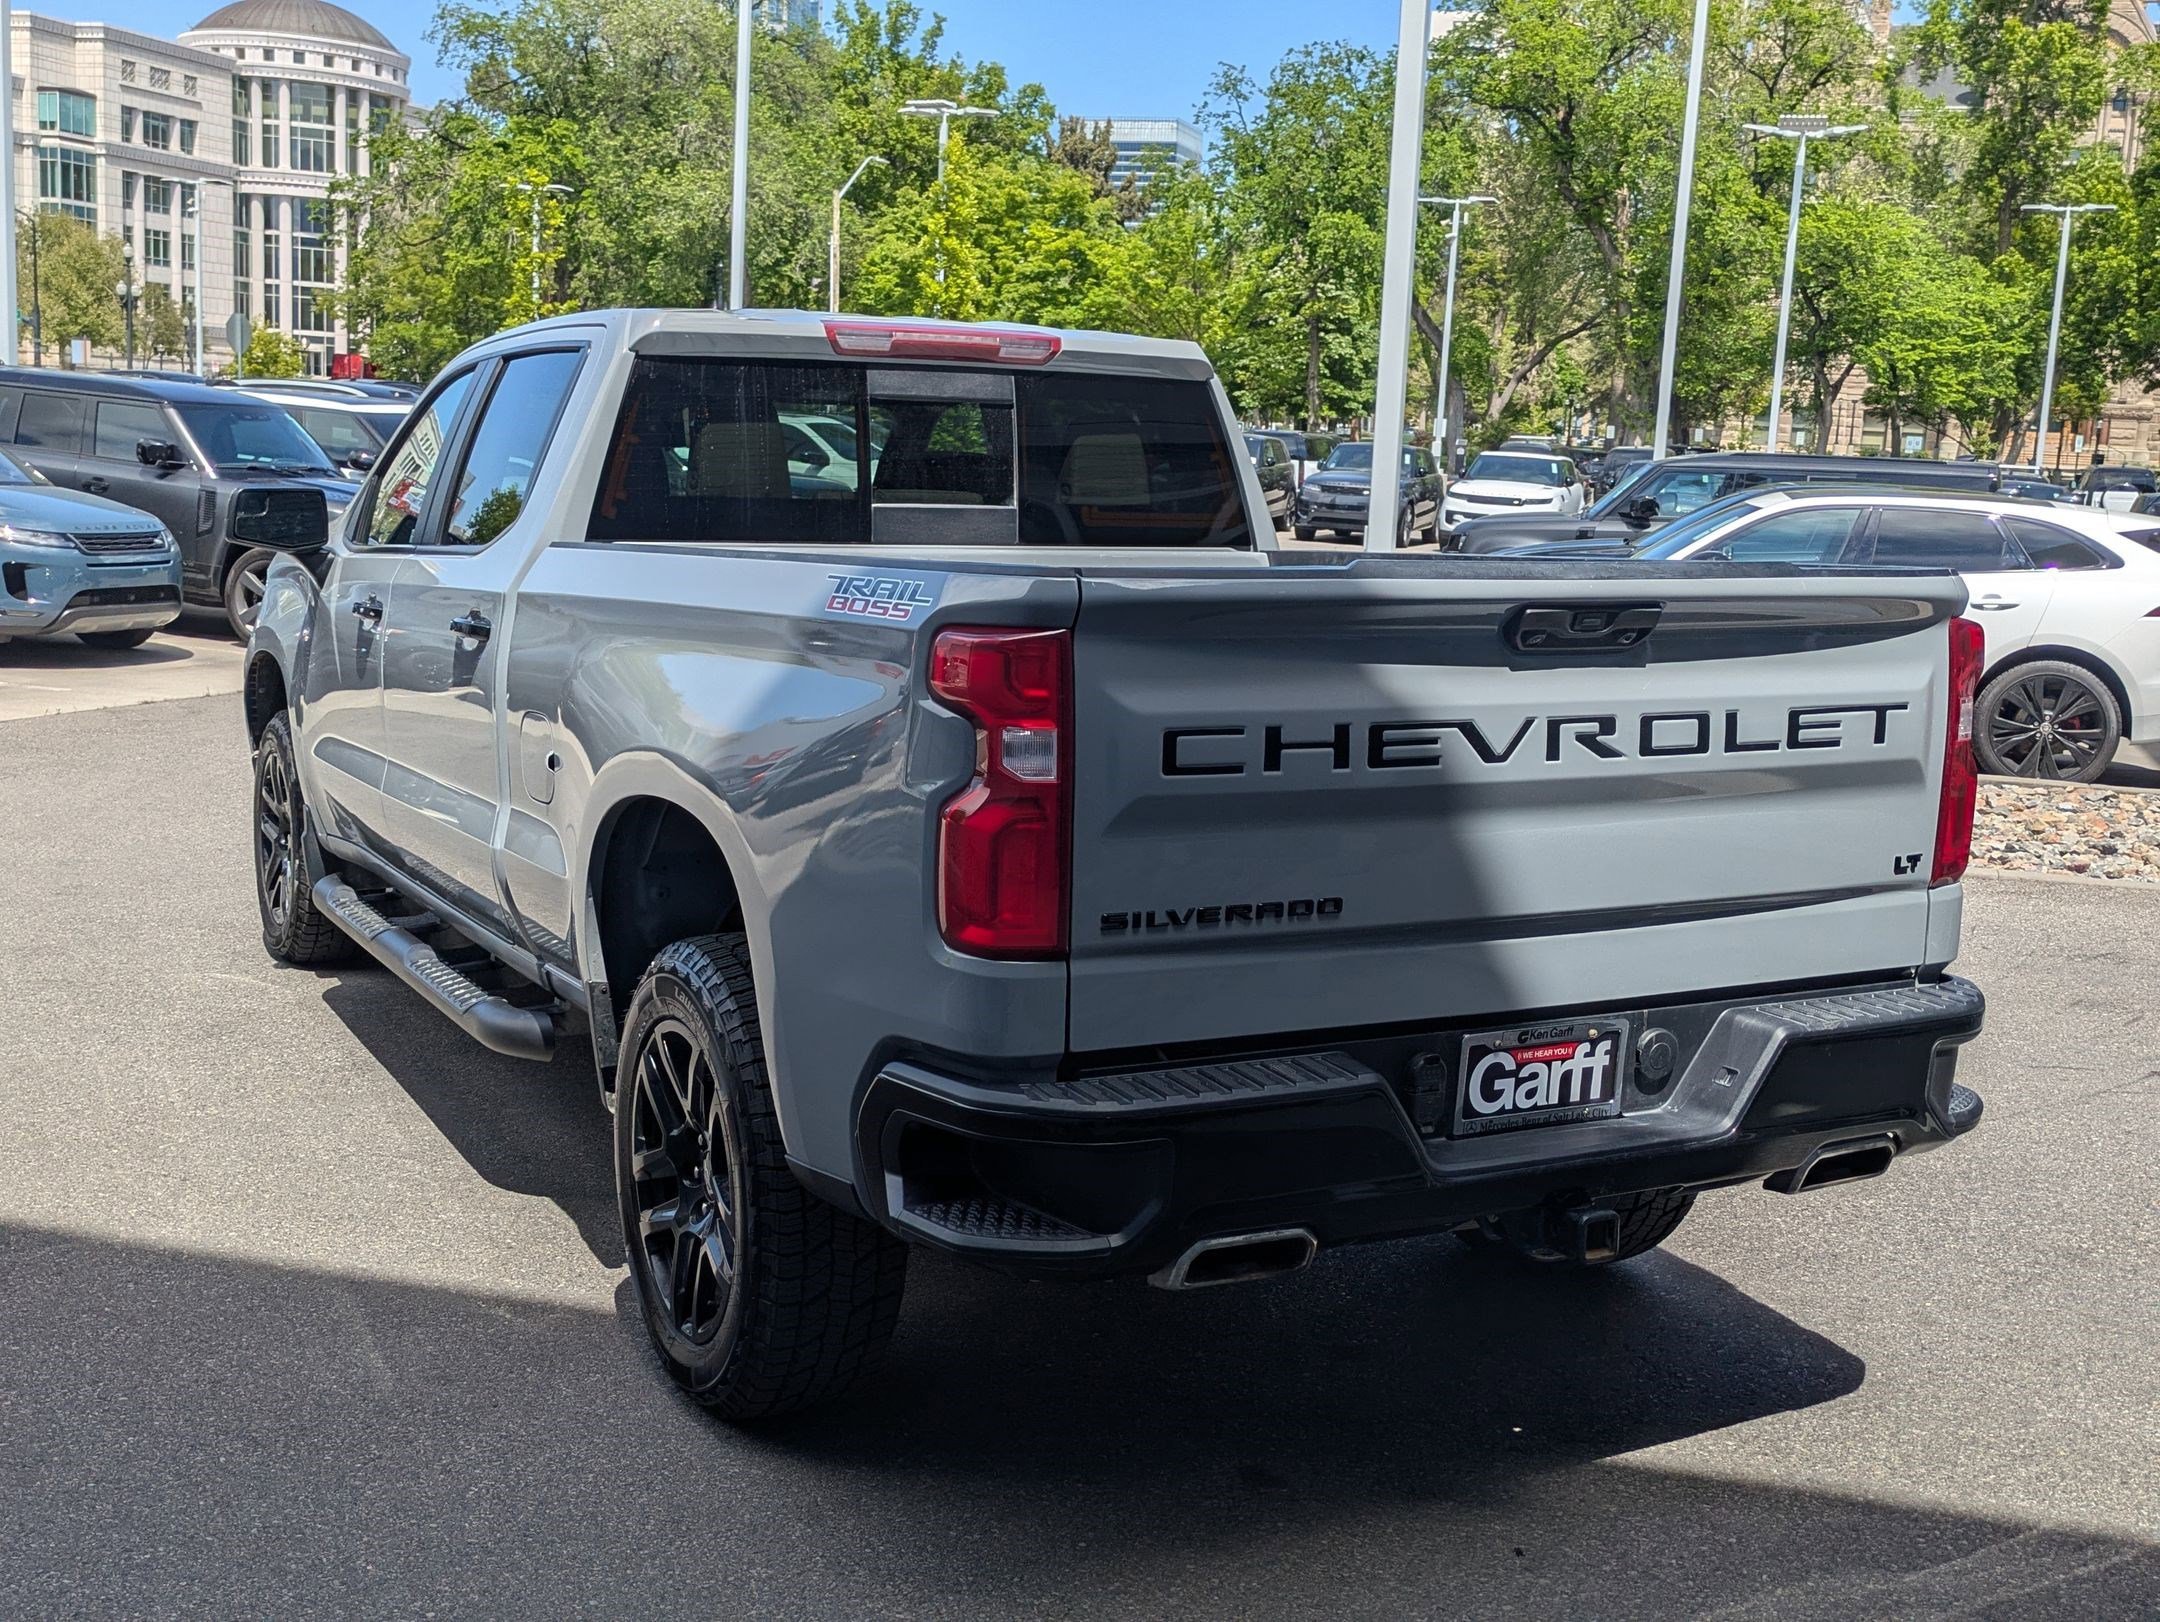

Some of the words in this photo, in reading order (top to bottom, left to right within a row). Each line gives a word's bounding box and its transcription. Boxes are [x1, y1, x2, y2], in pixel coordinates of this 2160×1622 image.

[827, 573, 933, 605] TRAIL
[825, 594, 914, 621] BOSS
[1161, 703, 1909, 776] CHEVROLET
[1893, 853, 1923, 875] LT
[1100, 897, 1344, 931] SILVERADO
[1529, 1028, 1549, 1041] Ken
[1550, 1025, 1574, 1038] Garff
[1523, 1050, 1534, 1059] WE
[1534, 1049, 1553, 1058] HEAR
[1553, 1047, 1568, 1056] YOU
[1469, 1040, 1612, 1114] Garff
[1592, 1107, 1610, 1119] City
